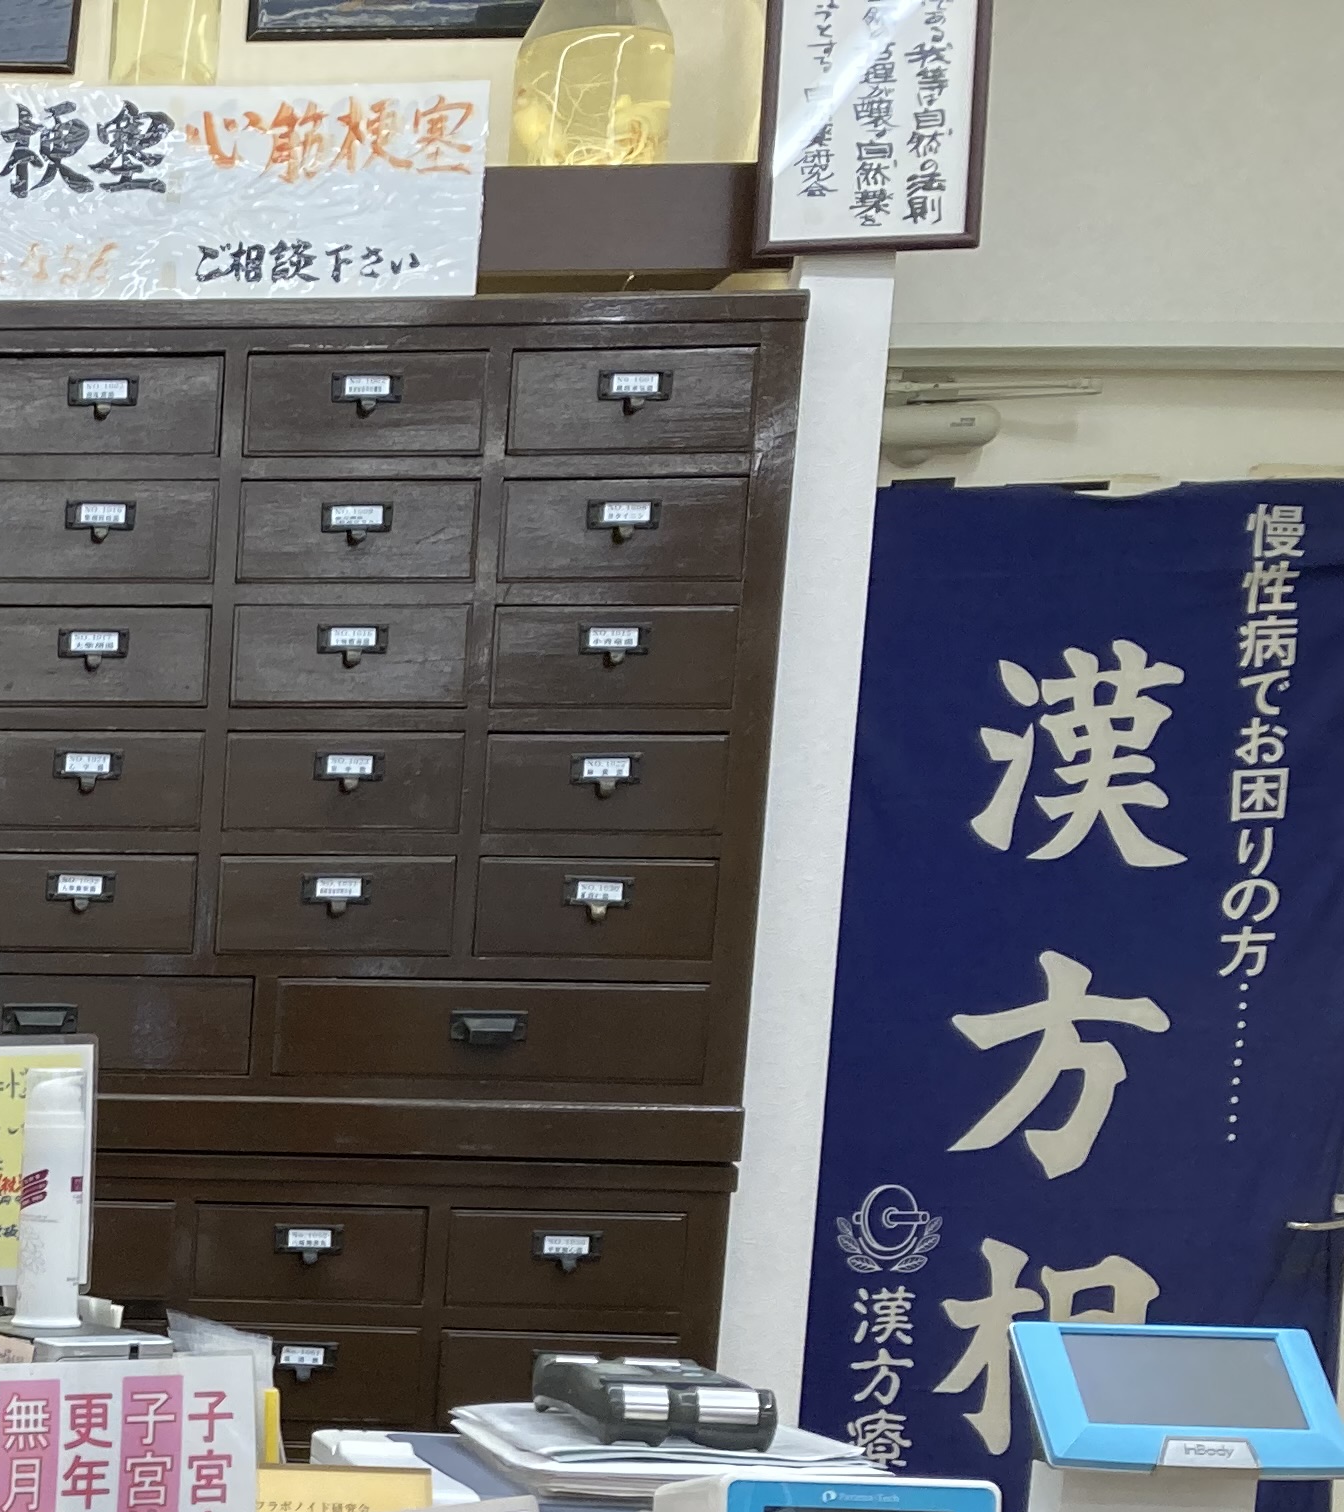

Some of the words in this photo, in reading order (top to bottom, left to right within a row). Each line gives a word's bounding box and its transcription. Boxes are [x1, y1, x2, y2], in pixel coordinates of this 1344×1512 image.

[195, 239, 421, 284] ご相談下さい
